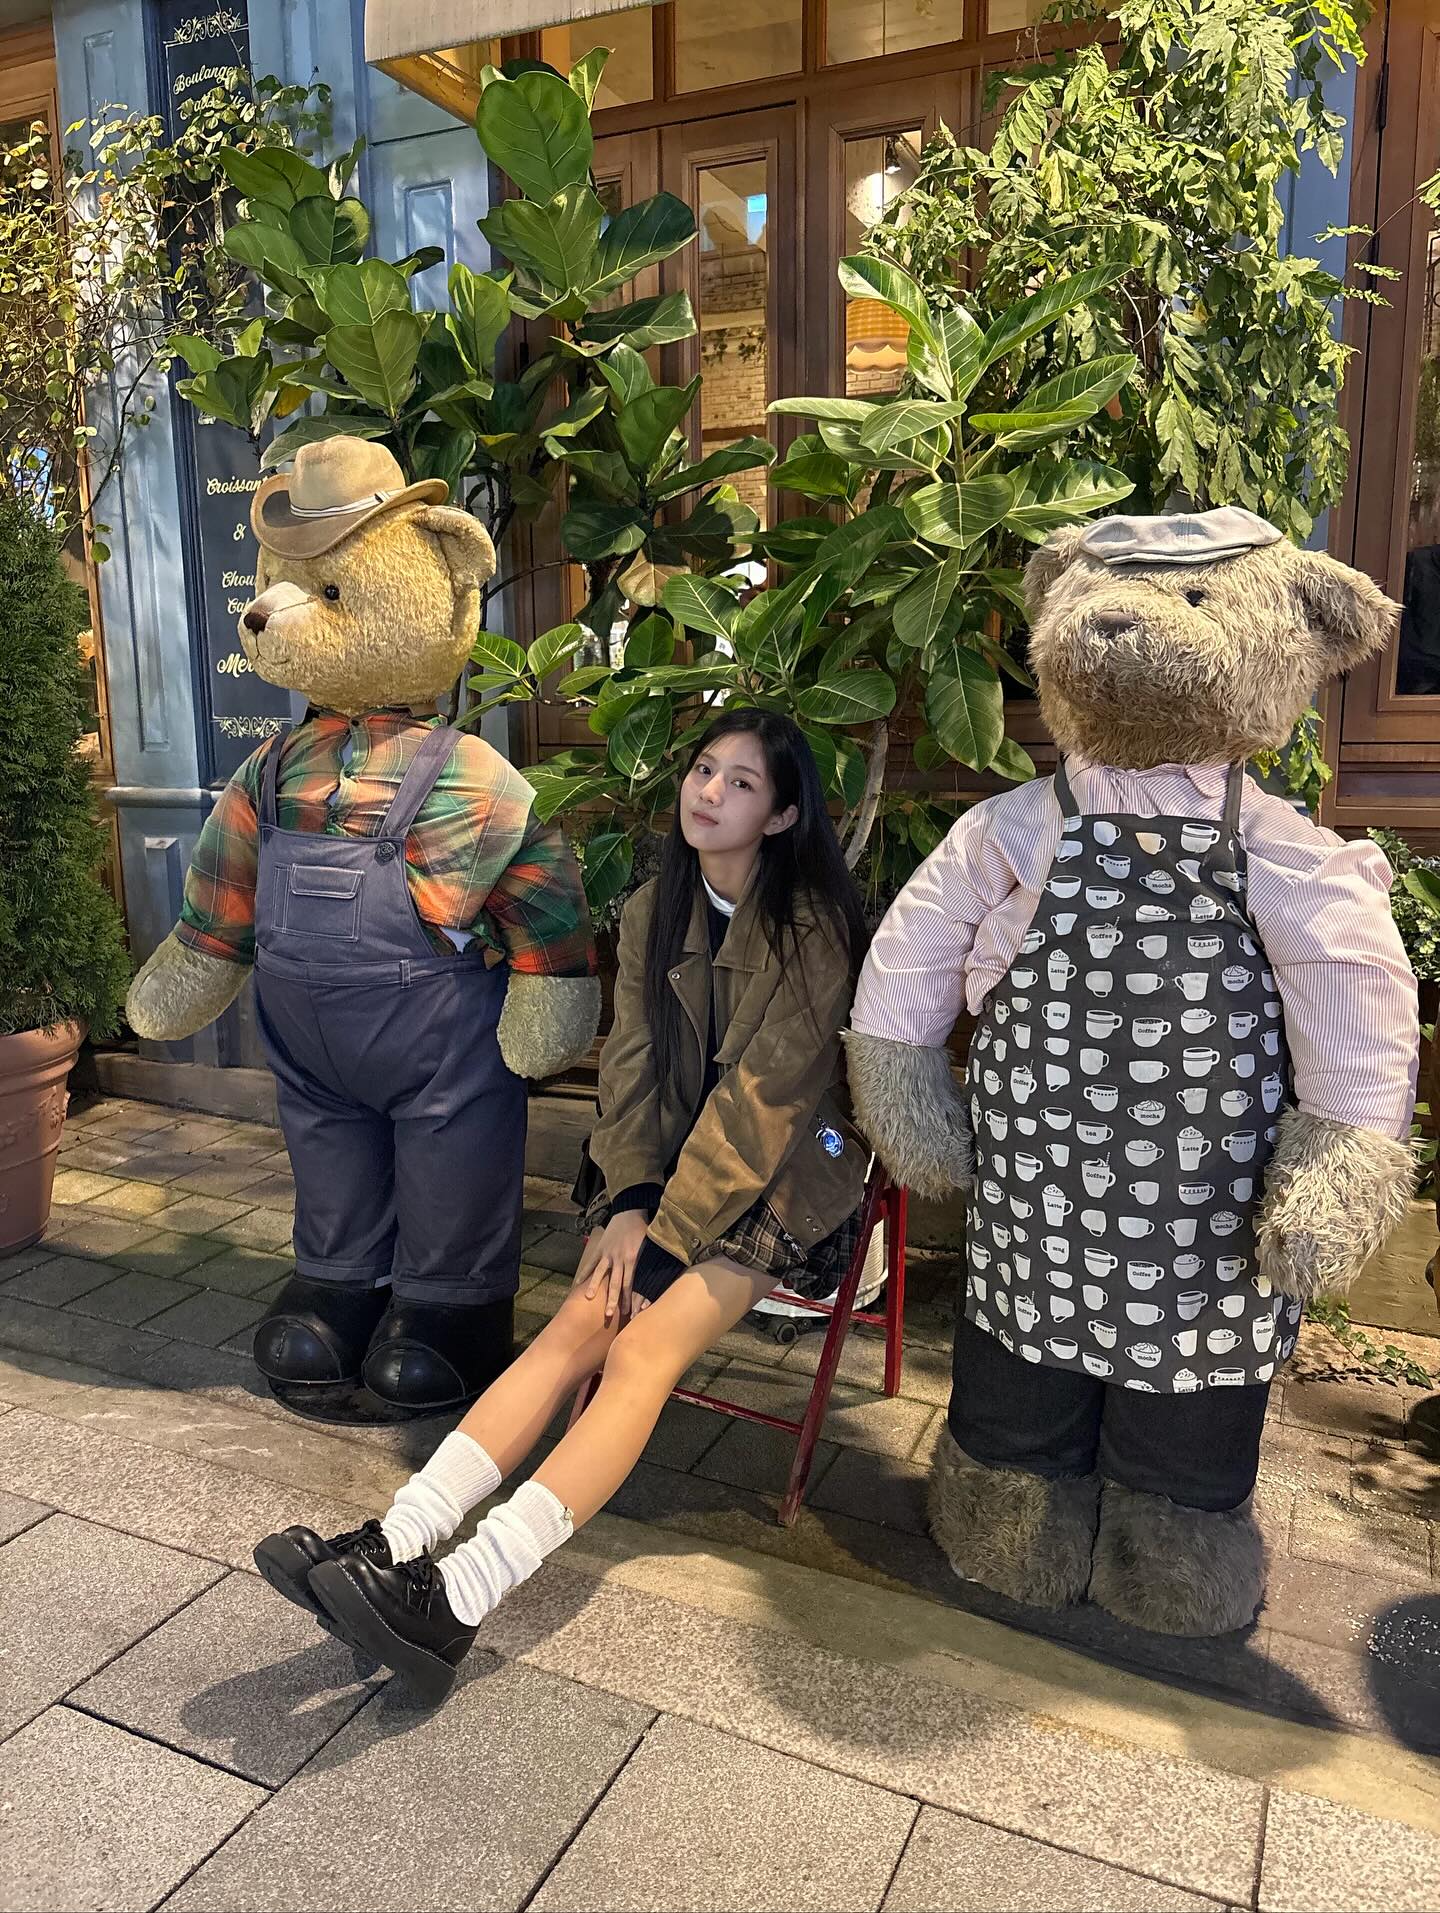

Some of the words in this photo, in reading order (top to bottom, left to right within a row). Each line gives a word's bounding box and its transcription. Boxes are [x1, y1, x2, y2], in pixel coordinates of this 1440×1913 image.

[173, 65, 250, 95] Boulange
[233, 523, 247, 541] &
[1013, 1078, 1029, 1086] Coffee
[1086, 1172, 1106, 1180] Coffee
[1017, 1306, 1032, 1315] Coffee
